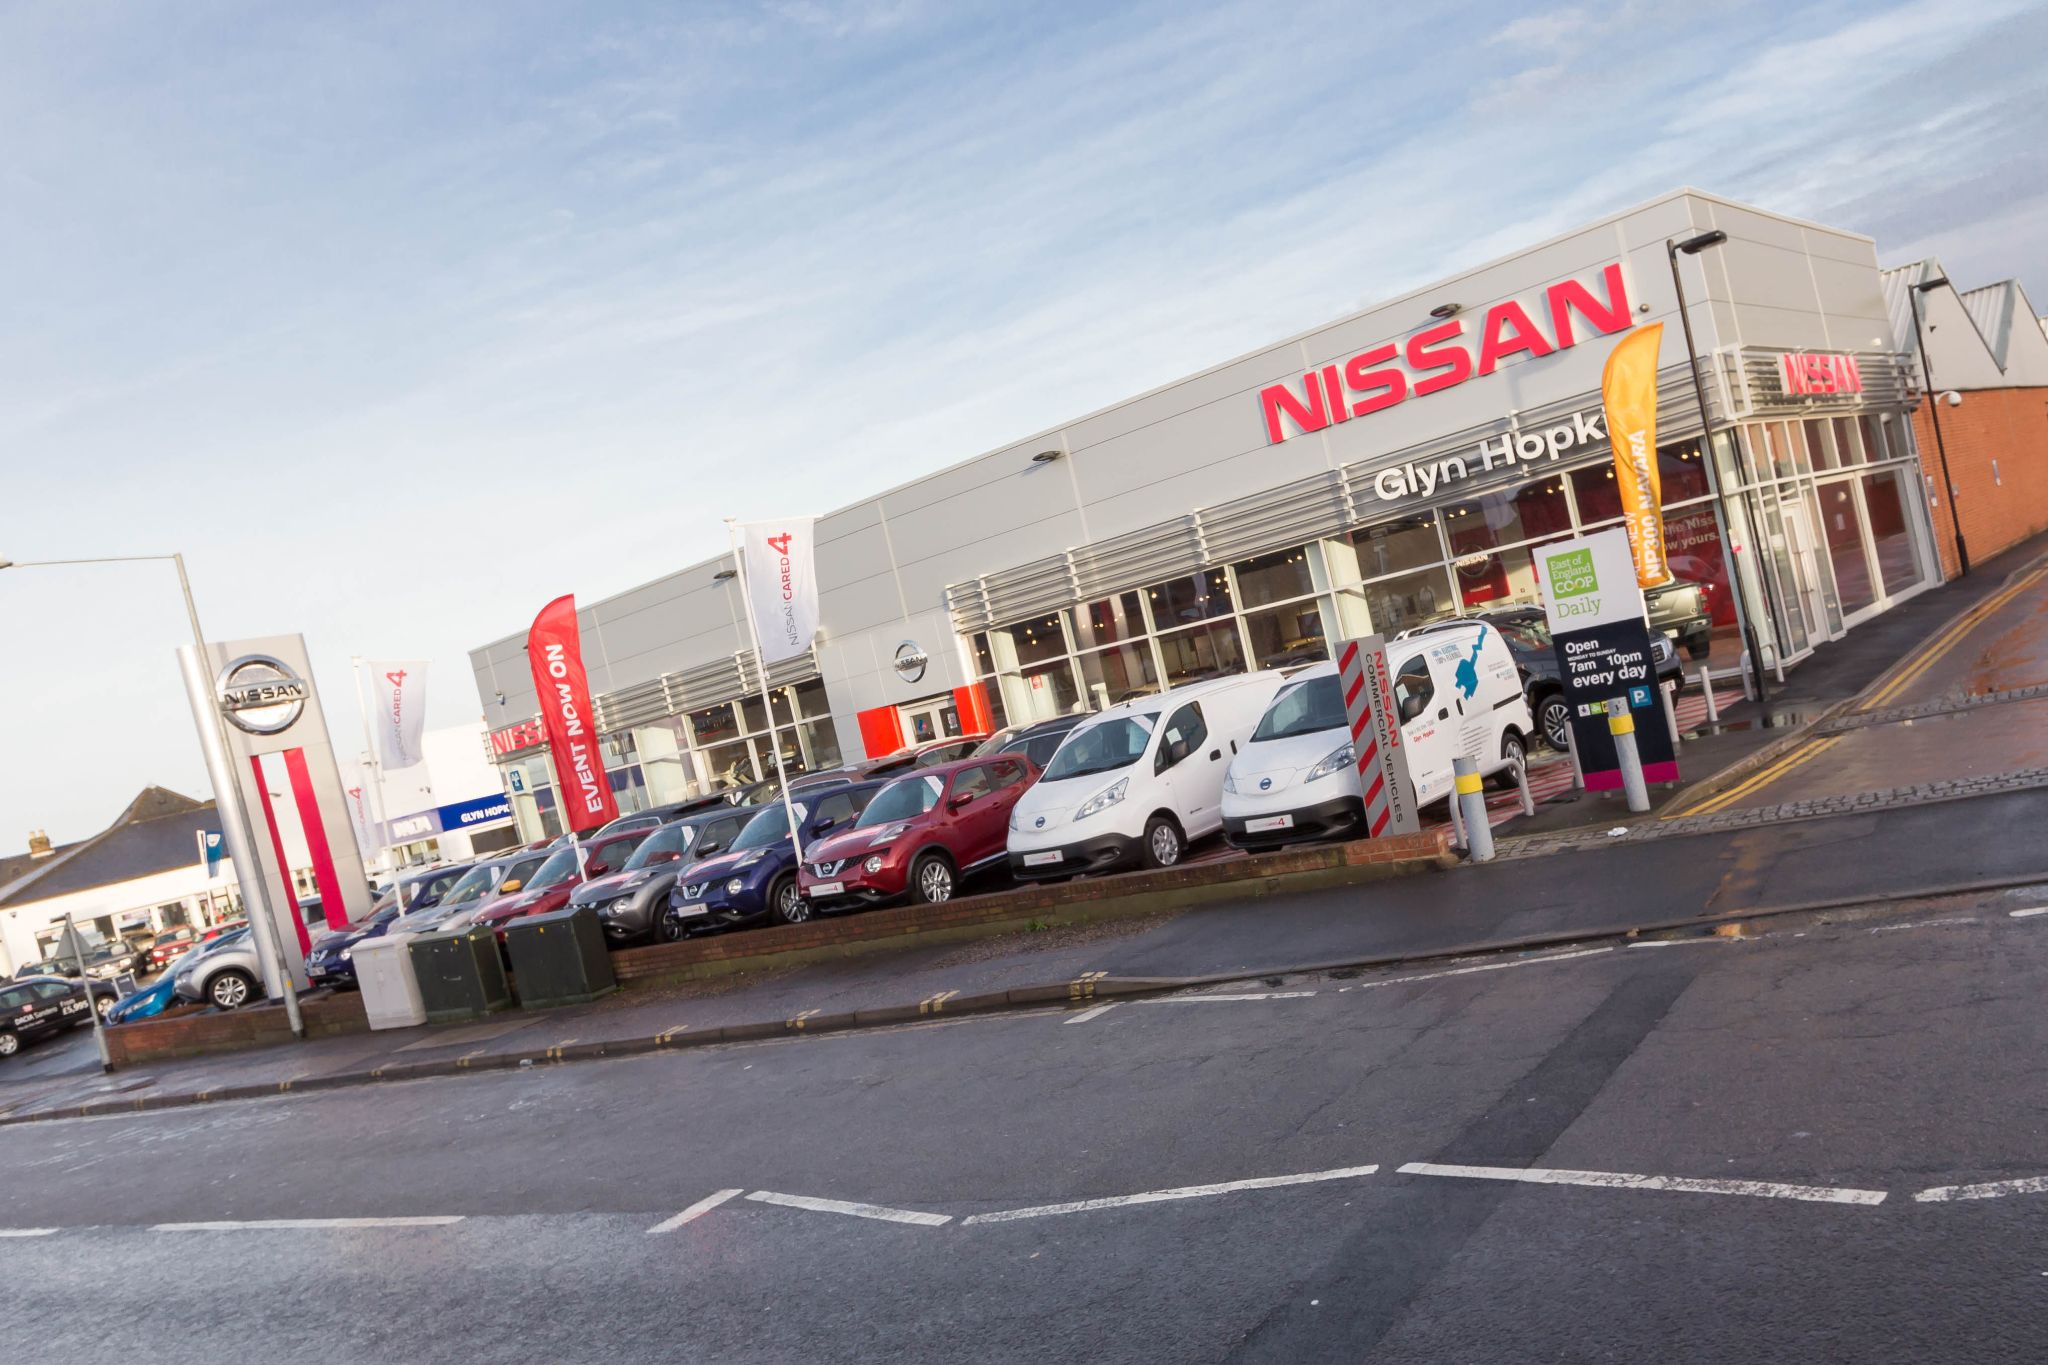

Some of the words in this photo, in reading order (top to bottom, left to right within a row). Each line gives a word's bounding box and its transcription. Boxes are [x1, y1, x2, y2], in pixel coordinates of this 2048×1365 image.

[1260, 262, 1634, 445] NISSAN
[1784, 352, 1862, 395] NISSAN
[1374, 455, 1468, 501] Glyn
[1628, 429, 1654, 510] NAVARA
[1625, 511, 1639, 544] NEW
[1550, 558, 1570, 571] East
[1572, 554, 1583, 566] of
[1642, 515, 1662, 579] NP300
[1552, 562, 1591, 581] England
[1556, 596, 1601, 619] Daily
[545, 643, 567, 679] ON
[1565, 640, 1599, 654] Open
[1567, 653, 1589, 662] MONDAY
[1596, 648, 1617, 656] SUNDAY
[1569, 660, 1597, 673] 7am
[1607, 652, 1642, 667] 10pm
[1573, 670, 1614, 688] every
[1618, 664, 1647, 680] day
[224, 683, 303, 705] NISSAN
[555, 683, 584, 737] NOW
[1373, 651, 1399, 748] NISSAN
[1633, 690, 1645, 704] P
[1365, 653, 1388, 750] COMMERCIAL
[1385, 753, 1403, 823] VEHICLES
[571, 742, 604, 814] EVENT
[461, 810, 485, 823] GLYN
